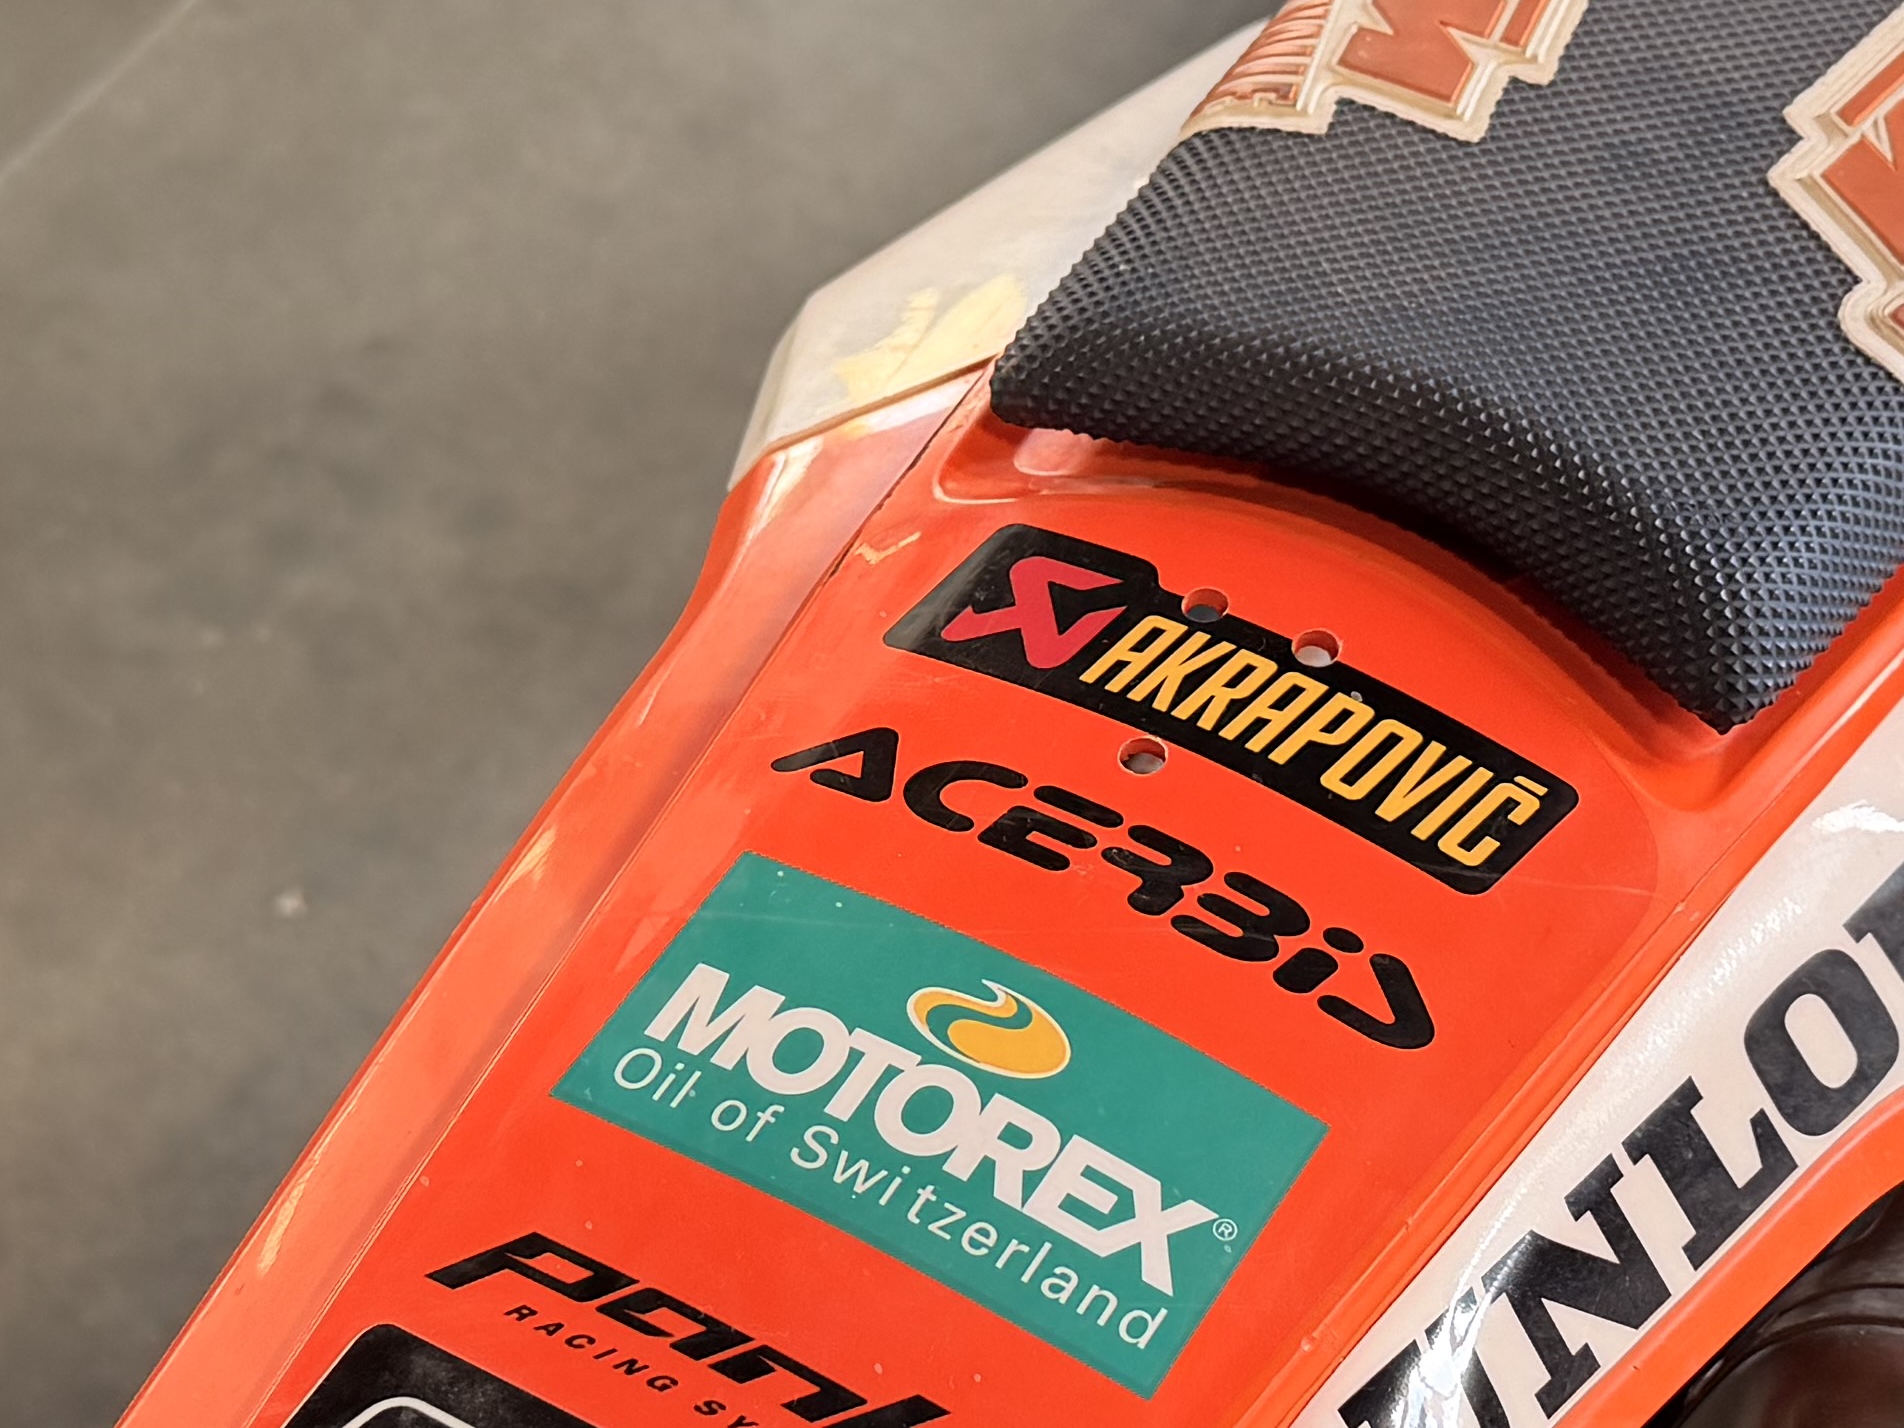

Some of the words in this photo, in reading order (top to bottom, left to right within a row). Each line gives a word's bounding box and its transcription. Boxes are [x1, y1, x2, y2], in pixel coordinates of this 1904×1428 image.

[612, 1047, 703, 1110] Oil
[709, 1099, 786, 1144] of
[789, 1124, 1169, 1351] Switzerland
[643, 962, 1220, 1298] MOTOREX
[502, 1303, 680, 1393] RACING
